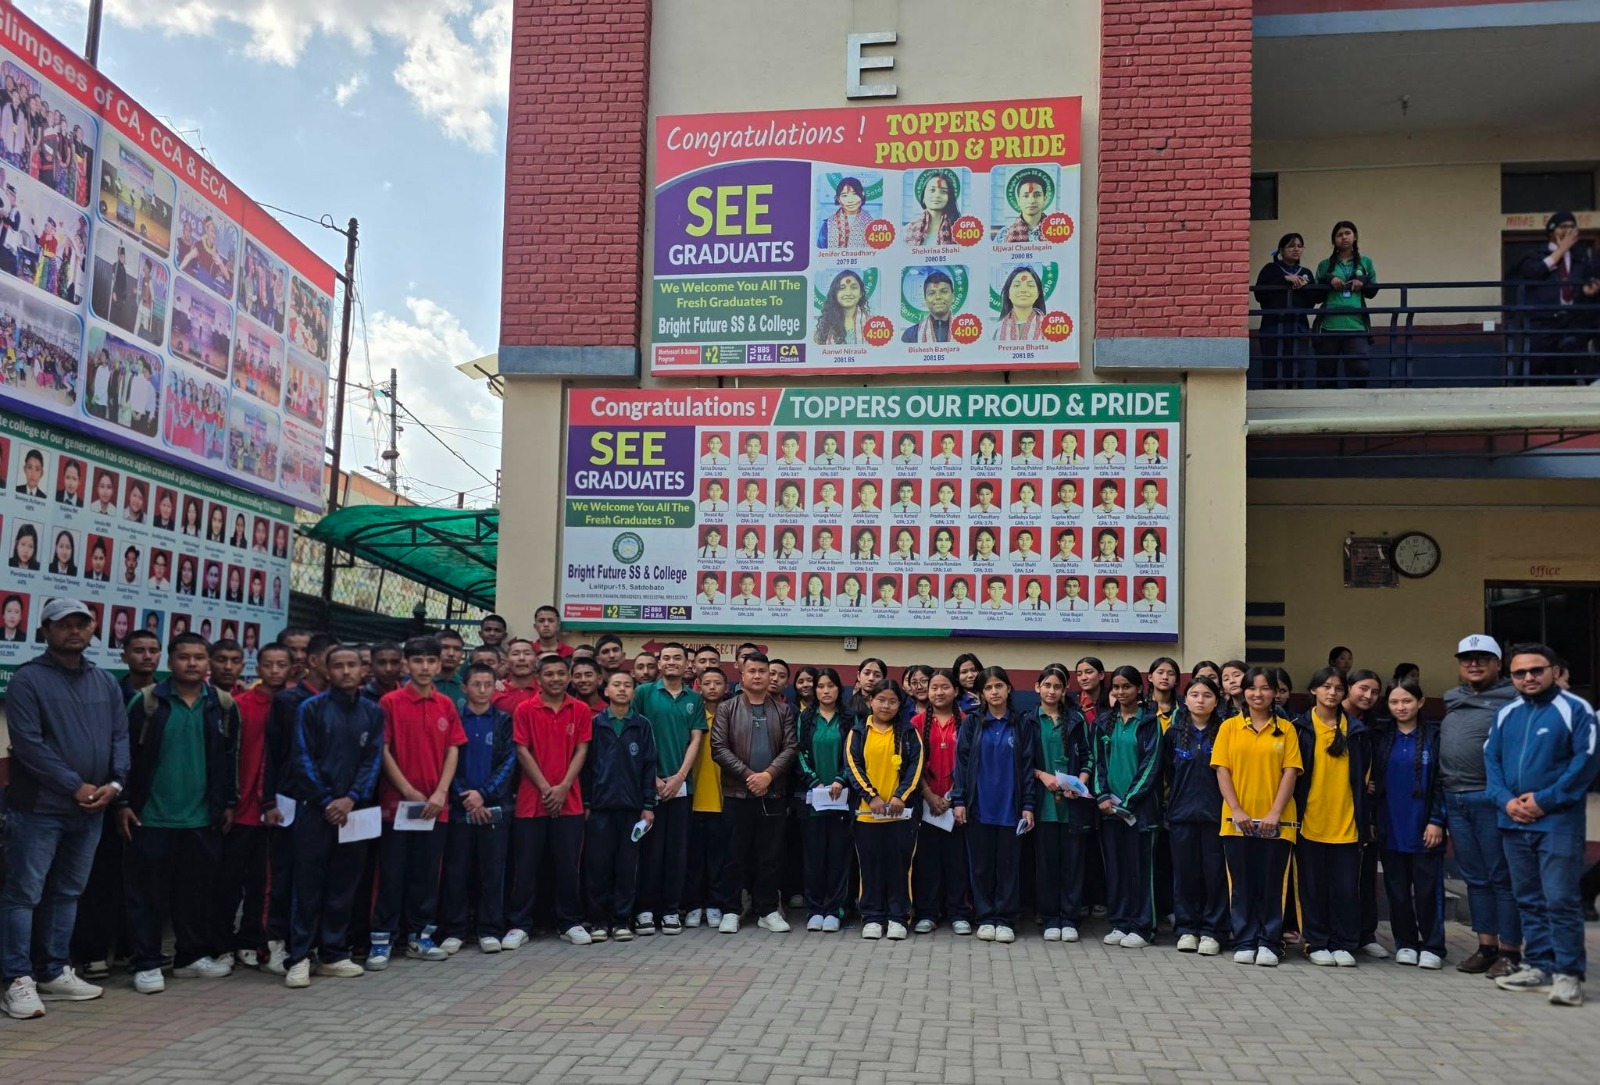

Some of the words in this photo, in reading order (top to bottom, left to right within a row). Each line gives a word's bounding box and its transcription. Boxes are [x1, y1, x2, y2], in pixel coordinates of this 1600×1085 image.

[847, 31, 897, 100] E
[886, 109, 996, 136] TOPPERS
[1001, 107, 1055, 131] OUR
[94, 86, 113, 111] of
[116, 100, 145, 141] CA,
[150, 127, 183, 169] CCA
[186, 157, 197, 179] &
[200, 166, 228, 205] ECA
[666, 120, 845, 157] Congratulations
[875, 139, 959, 164] PROUD
[964, 138, 985, 160] &
[989, 134, 1066, 159] PRIDE
[685, 184, 773, 237] SEE
[872, 224, 888, 232] GPA
[956, 228, 980, 239] 4:00
[1045, 225, 1071, 236] 4:00
[868, 232, 892, 242] 4:00
[668, 240, 795, 266] GRADUATES
[841, 250, 877, 258] Chaudhary
[660, 283, 680, 293] We
[682, 281, 735, 293] Welcome
[737, 280, 758, 291] You
[760, 280, 777, 291] All
[779, 279, 801, 290] The
[676, 297, 707, 309] Fresh
[709, 296, 768, 307] Graduates
[769, 295, 783, 306] To
[658, 316, 691, 338] Bright
[693, 316, 728, 334] Future
[730, 315, 745, 333] SS
[748, 315, 756, 332] &
[759, 314, 800, 336] College
[958, 318, 975, 326] GPA
[866, 328, 890, 339] 4:00
[954, 326, 979, 337] 4:00
[1044, 324, 1070, 335] 4:00
[705, 345, 718, 363] +2
[780, 345, 799, 356] CA
[590, 396, 756, 421] Congratulations
[790, 396, 900, 419] TOPPERS
[905, 394, 962, 419] OUR
[967, 393, 1061, 417] PROUD
[1065, 393, 1085, 416] &
[1090, 392, 1170, 416] PRIDE
[9, 420, 39, 438] college
[40, 429, 49, 440] of
[50, 434, 64, 445] our
[64, 438, 104, 458] generation
[105, 449, 118, 462] has
[118, 455, 134, 468] once
[134, 460, 152, 475] again
[152, 465, 175, 482] created
[589, 431, 667, 466] SEE
[574, 470, 685, 490] GRADUATES
[571, 503, 589, 512] We
[591, 502, 635, 512] Welcome
[636, 503, 655, 512] You
[656, 502, 670, 512] All
[671, 503, 690, 513] The
[585, 515, 609, 525] Fresh
[613, 515, 662, 525] Graduates
[664, 516, 675, 526] To
[568, 564, 595, 582] Bright
[597, 564, 627, 579] Future
[629, 565, 641, 580] SS
[643, 565, 651, 580] &
[653, 565, 688, 584] College
[589, 583, 628, 591] Lalitpur-15,
[607, 606, 618, 618] +2
[670, 606, 686, 615] CA
[715, 643, 742, 655] SECTI
